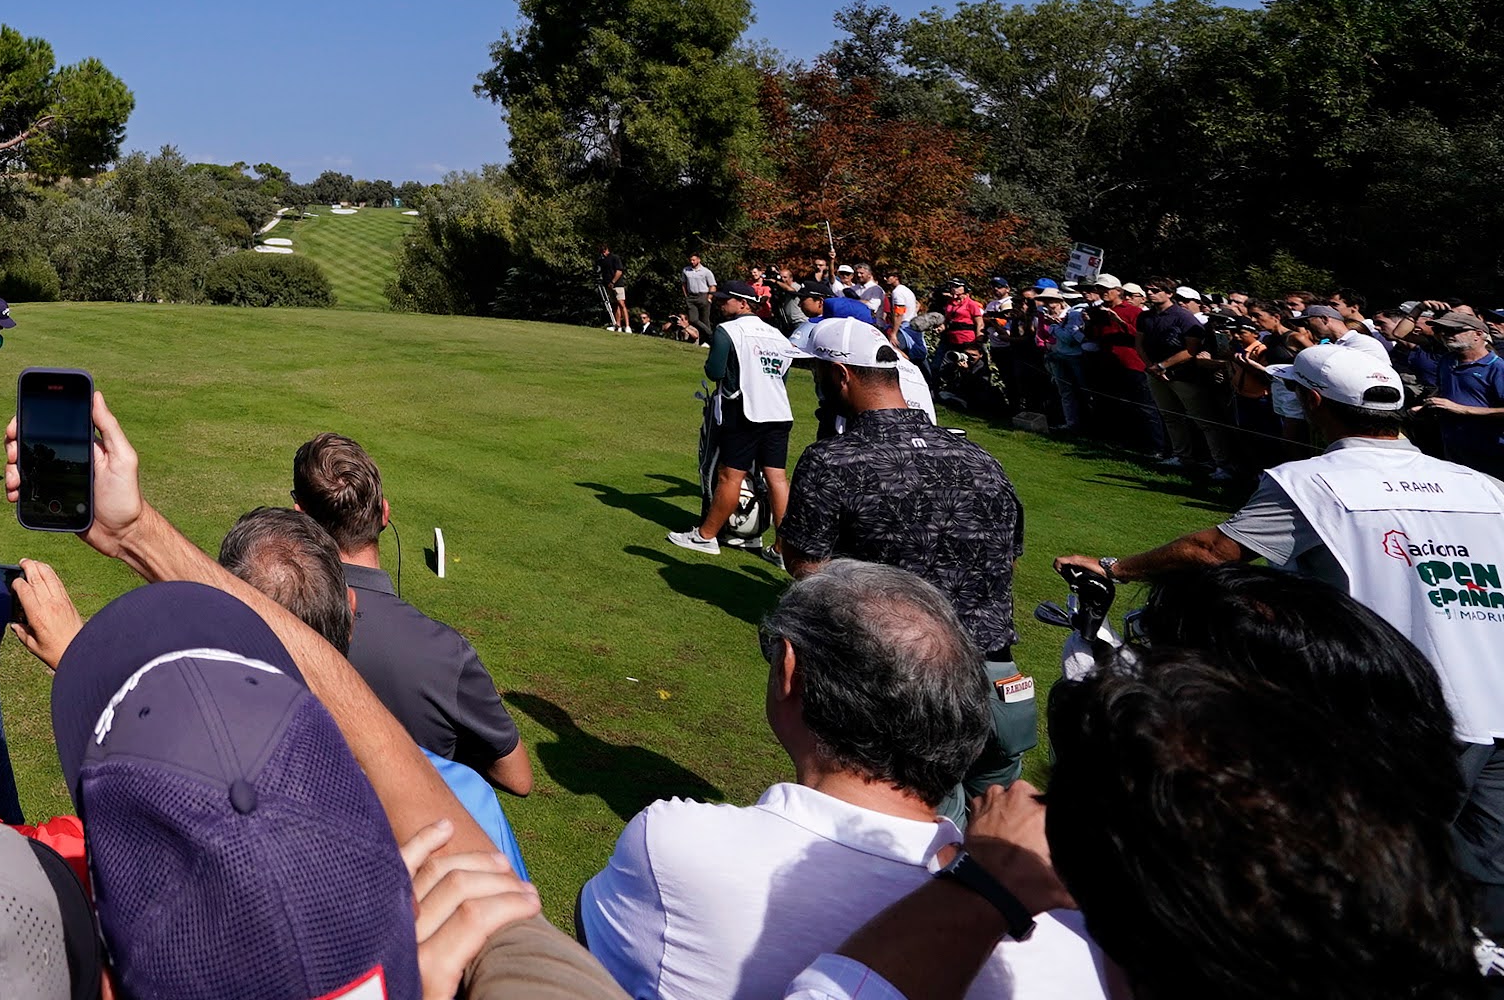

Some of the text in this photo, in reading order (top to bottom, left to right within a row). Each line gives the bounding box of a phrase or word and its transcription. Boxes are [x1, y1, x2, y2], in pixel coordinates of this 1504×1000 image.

[1382, 481, 1444, 494] J. RAHM
[1416, 560, 1502, 589] OPEN
[1459, 610, 1504, 622] MADRI
